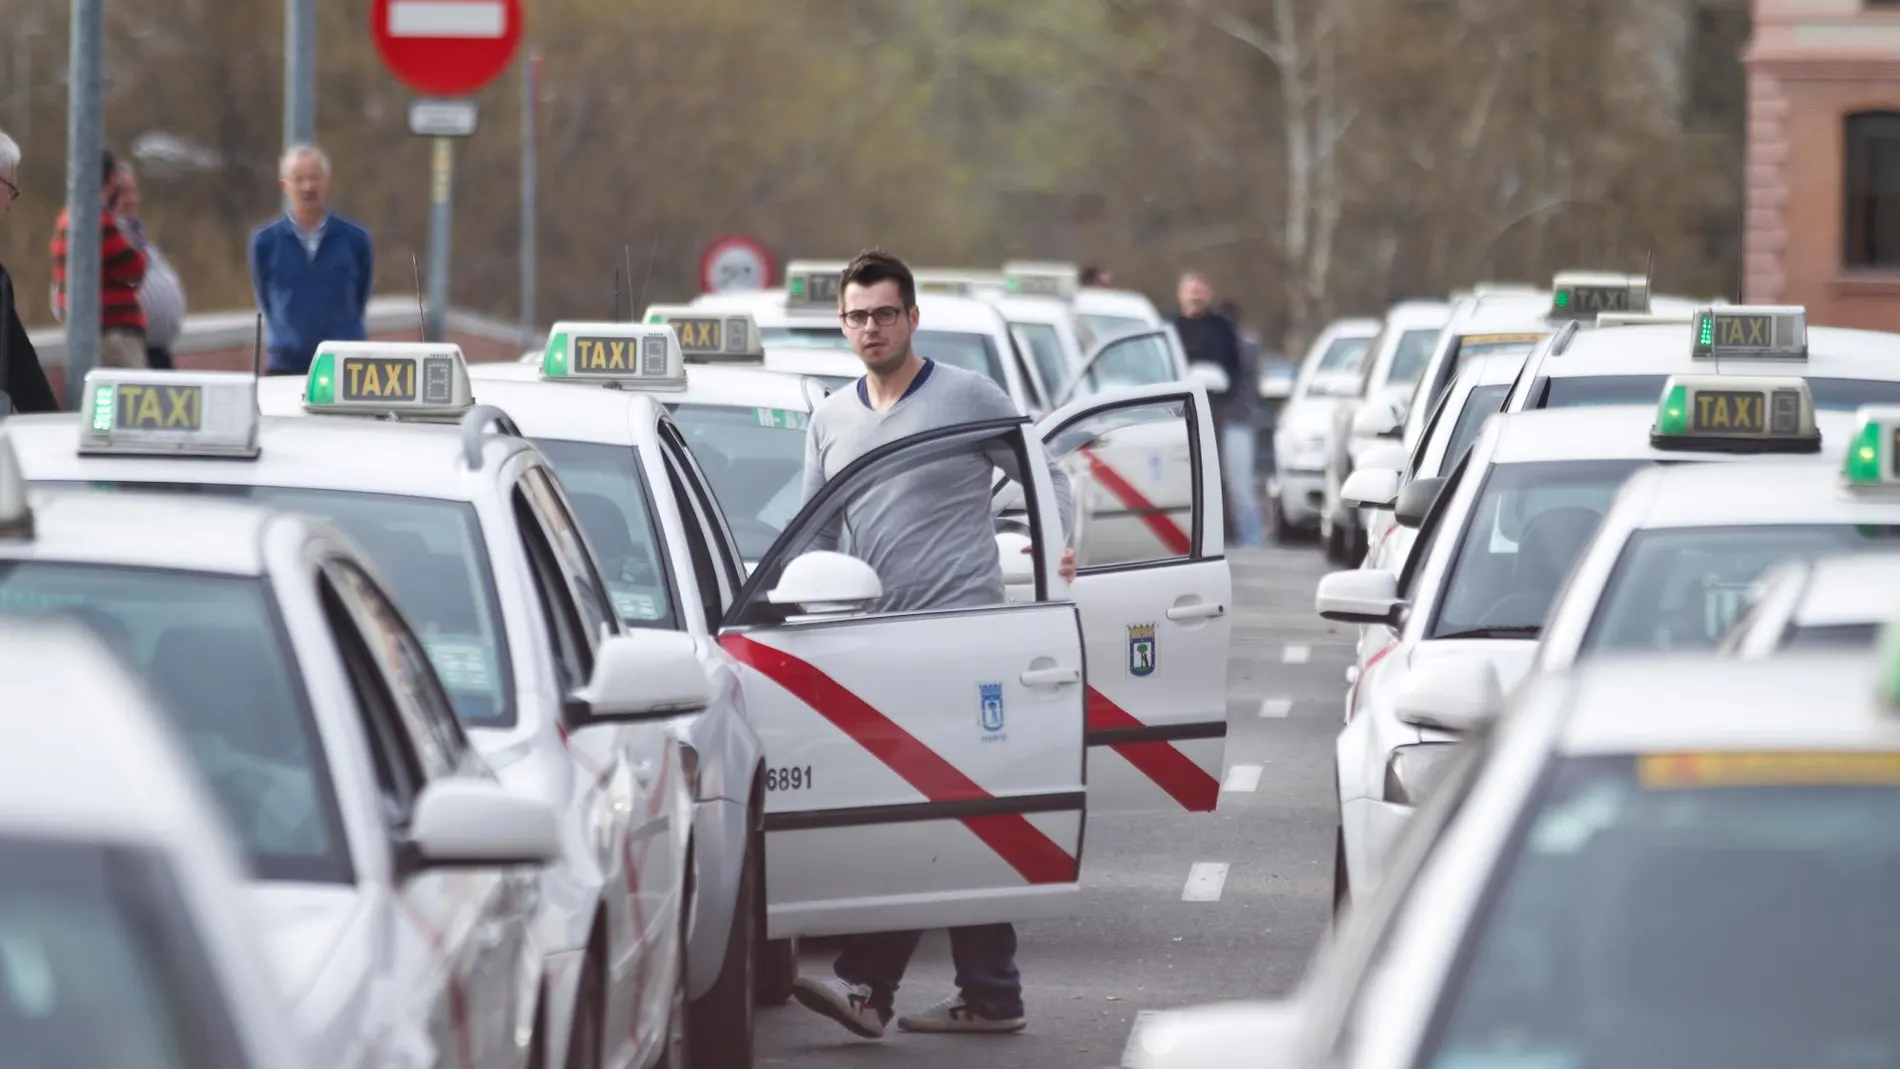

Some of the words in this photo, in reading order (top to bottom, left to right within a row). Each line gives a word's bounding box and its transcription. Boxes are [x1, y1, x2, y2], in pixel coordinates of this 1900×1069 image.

[1577, 289, 1629, 310] TAXI
[1717, 317, 1771, 345] TAXI
[577, 340, 635, 370] TAXI
[346, 363, 415, 397] TAXI
[120, 387, 201, 427] TAXI
[1697, 396, 1763, 428] TAXI
[766, 765, 811, 792] 6891
